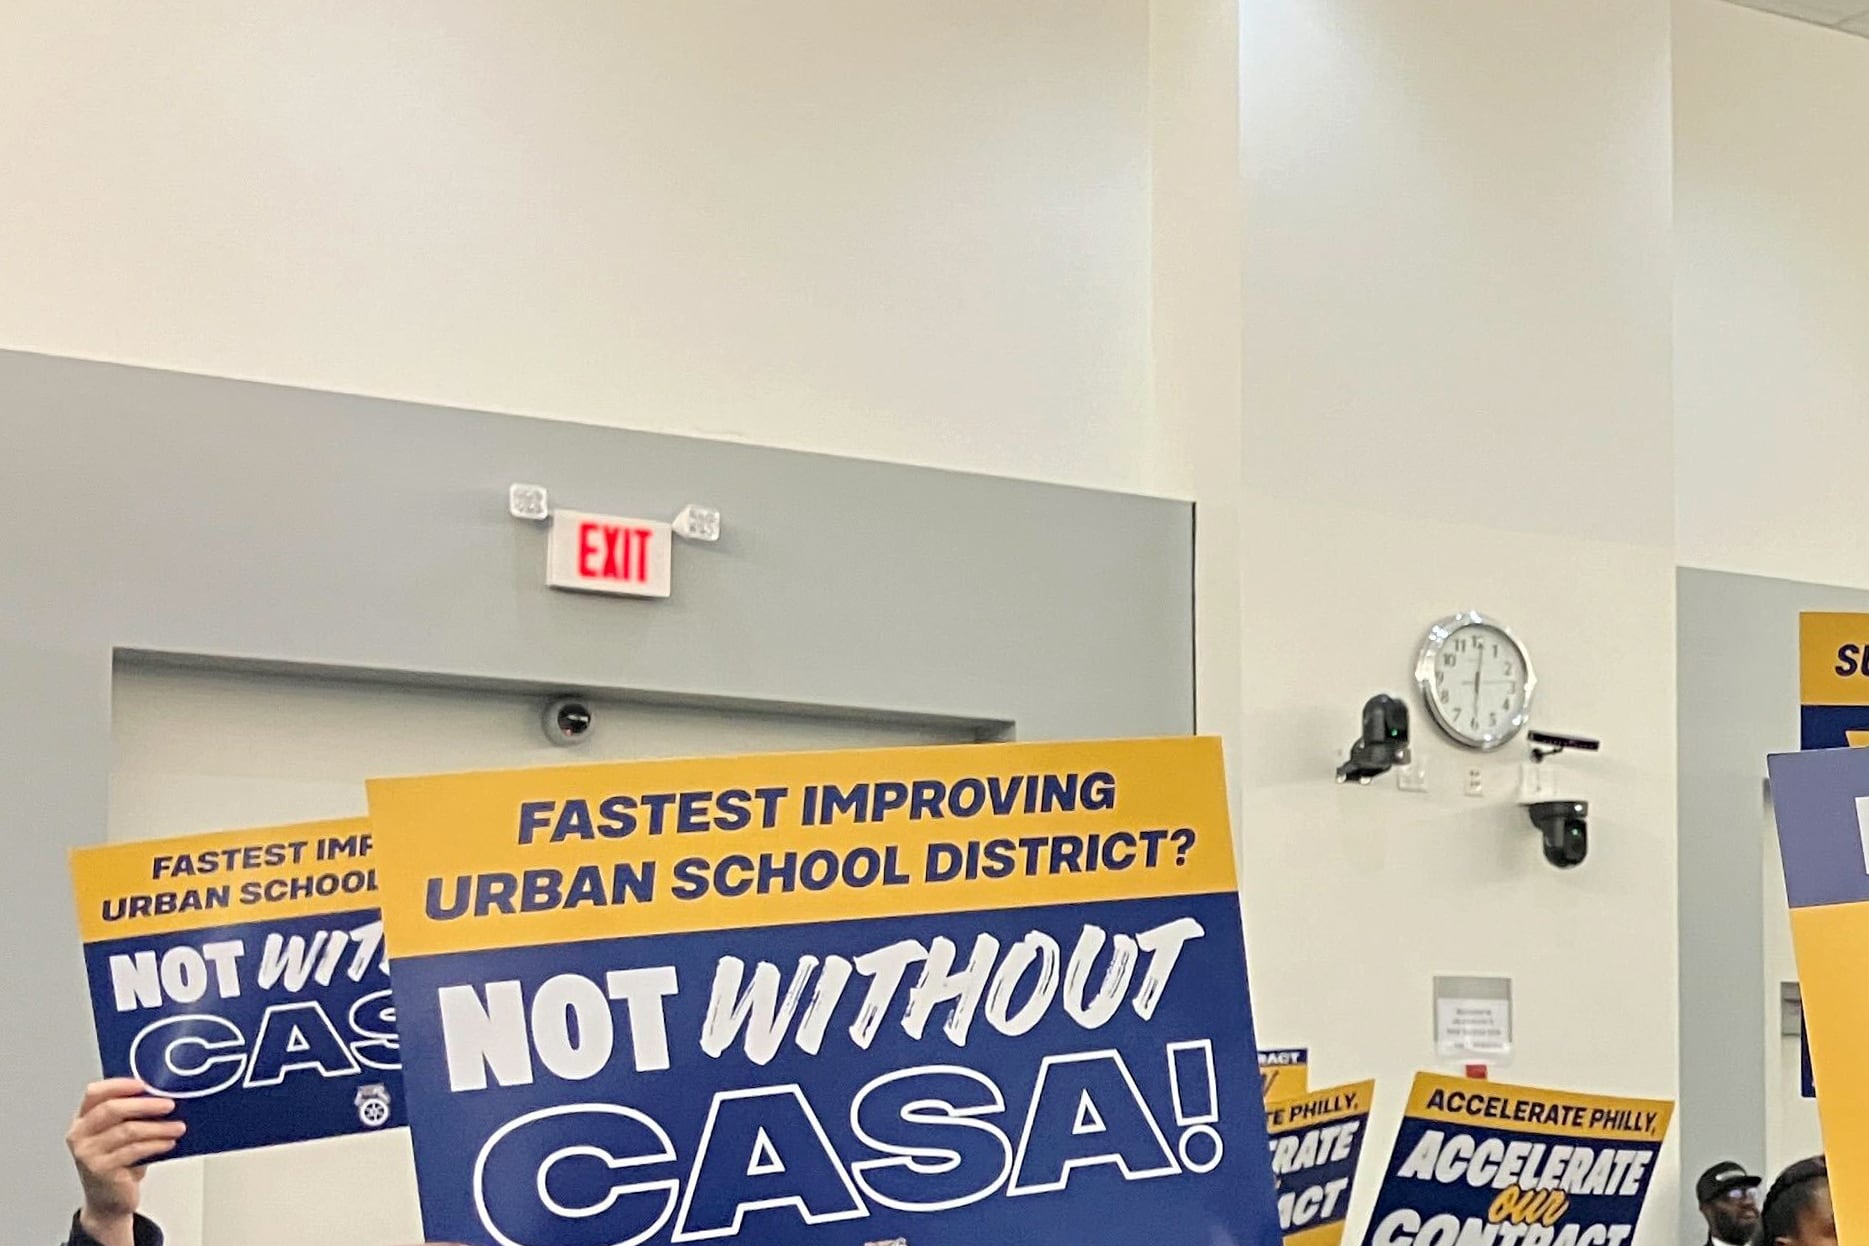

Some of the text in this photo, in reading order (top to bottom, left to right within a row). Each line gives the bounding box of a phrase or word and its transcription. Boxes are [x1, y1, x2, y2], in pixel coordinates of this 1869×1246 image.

[578, 521, 652, 584] EXIT
[517, 771, 1116, 845] FASTEST IMPROVING
[153, 841, 307, 879] FASTEST
[425, 827, 1196, 920] URBAN SCHOOL DISTRICT?
[102, 869, 378, 922] URBAN SCHOOL
[110, 940, 244, 1012] NOT
[439, 917, 1204, 1092] NOT WITHOUT
[1289, 1093, 1359, 1122] PHILLY,
[1426, 1089, 1658, 1135] ACCELERATE PHILLY,
[1398, 1129, 1653, 1196] ACCELERATE
[1487, 1184, 1570, 1226] our
